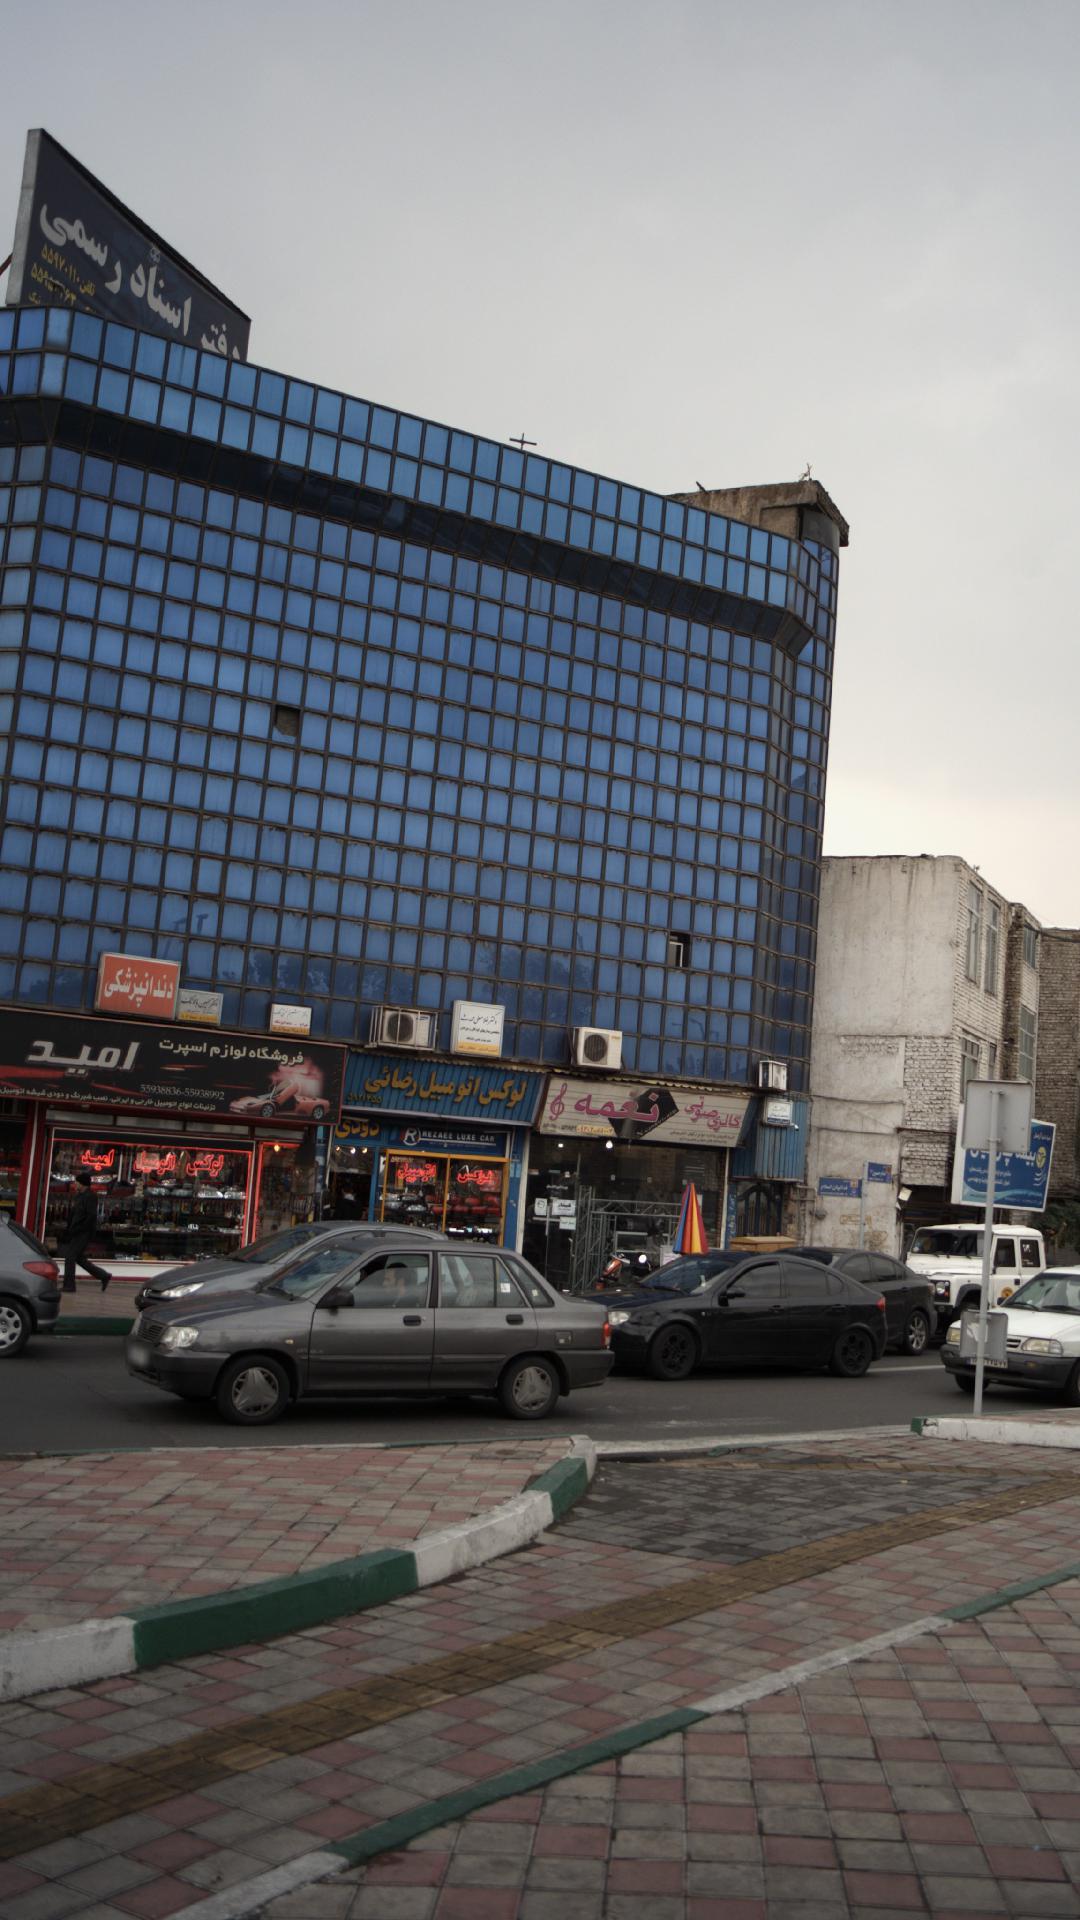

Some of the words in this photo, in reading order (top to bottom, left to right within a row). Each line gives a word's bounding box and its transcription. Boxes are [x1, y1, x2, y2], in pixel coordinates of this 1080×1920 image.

[40, 203, 122, 295] رسمی
[104, 967, 174, 1009] دندانپزشکی
[27, 1040, 140, 1076] امید
[159, 1039, 207, 1056] اسپرت
[209, 1044, 247, 1060] لوازم
[249, 1046, 304, 1066] فروشگاه
[479, 1080, 527, 1109] لوکس
[574, 1091, 660, 1123] نغمه
[457, 1132, 476, 1142] LUXE
[480, 1135, 495, 1143] CAR
